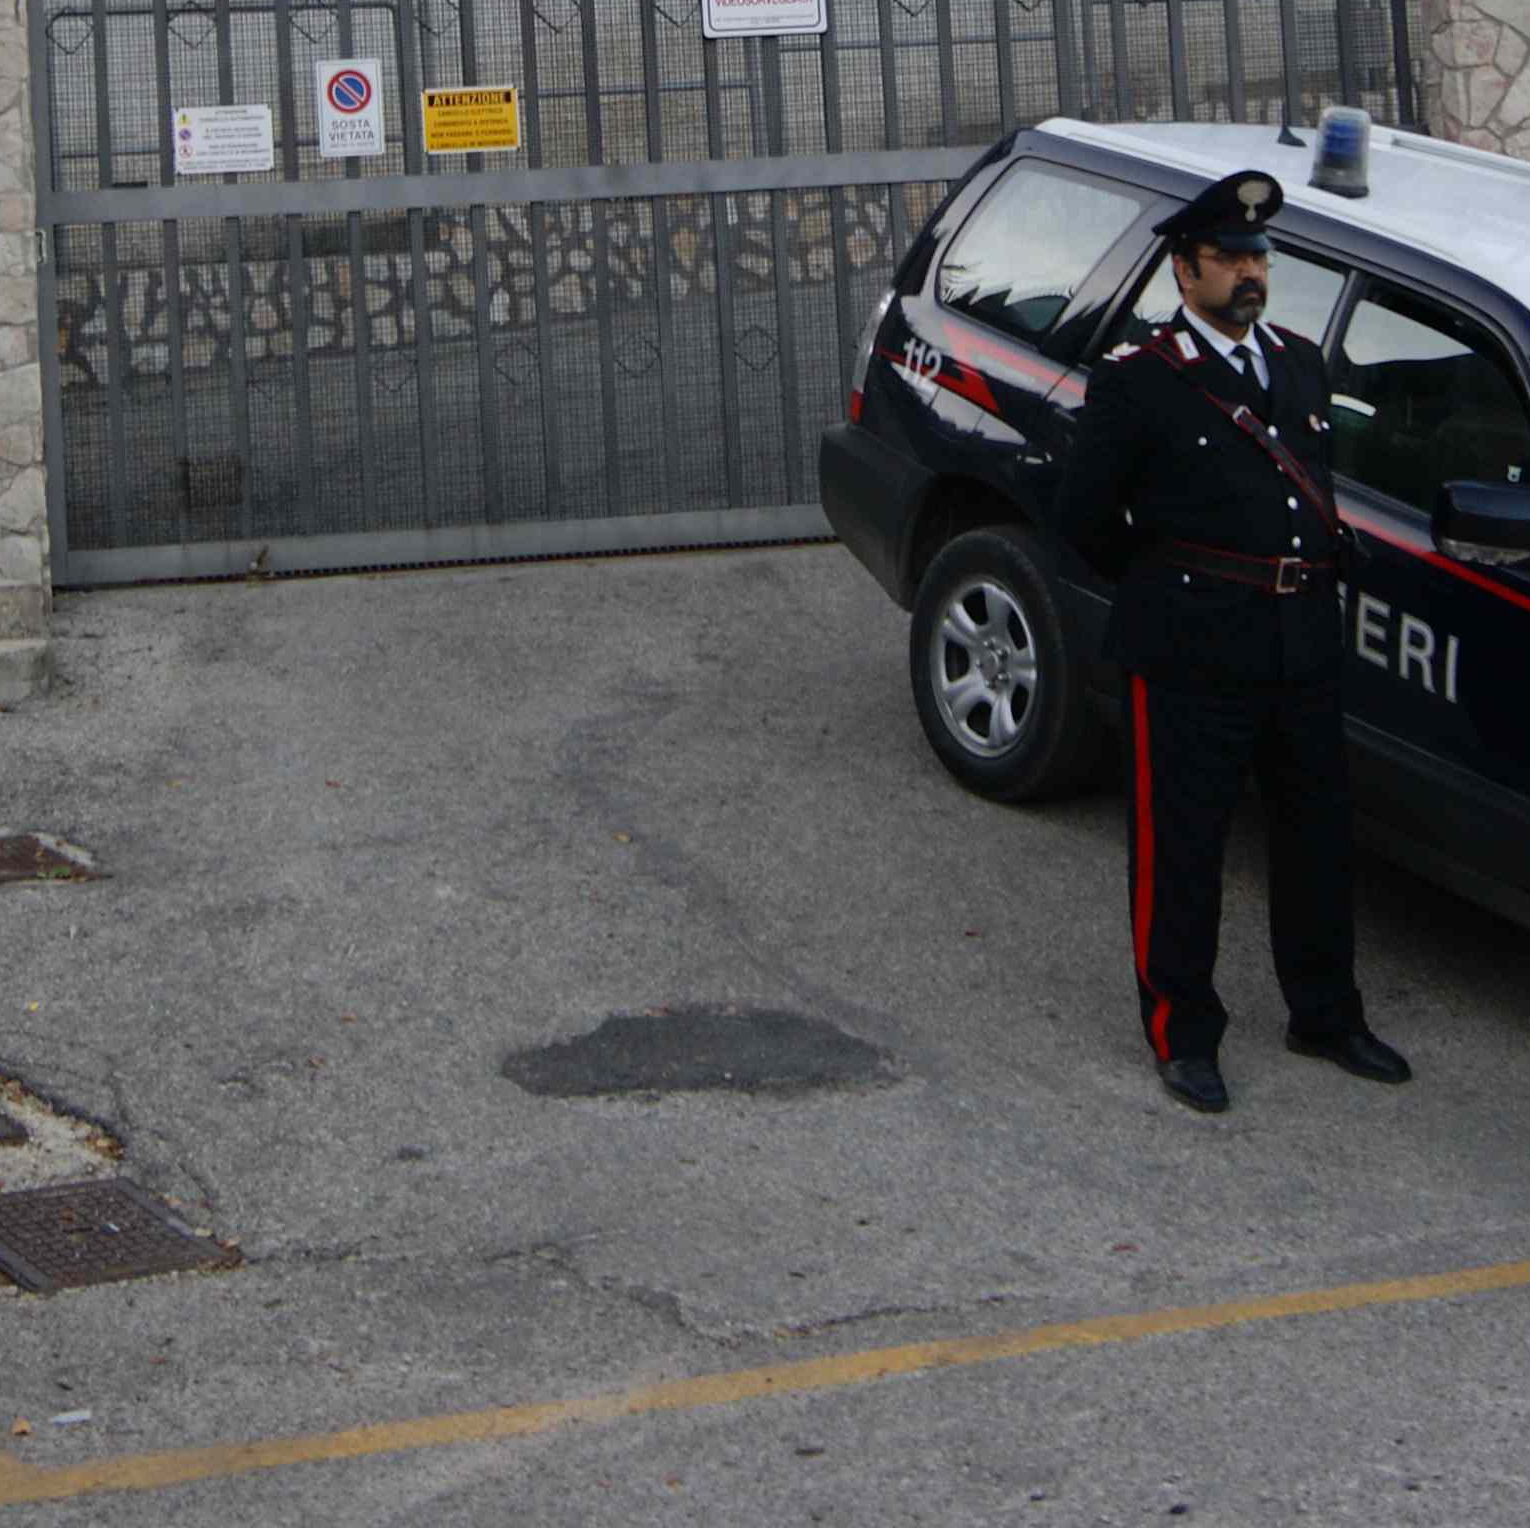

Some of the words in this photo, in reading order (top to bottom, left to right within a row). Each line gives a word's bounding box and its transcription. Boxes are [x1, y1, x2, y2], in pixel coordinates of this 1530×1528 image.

[434, 91, 503, 106] ATTENZIONE
[332, 119, 370, 129] SOSTA
[329, 131, 374, 142] VIETATA
[903, 338, 941, 380] 112
